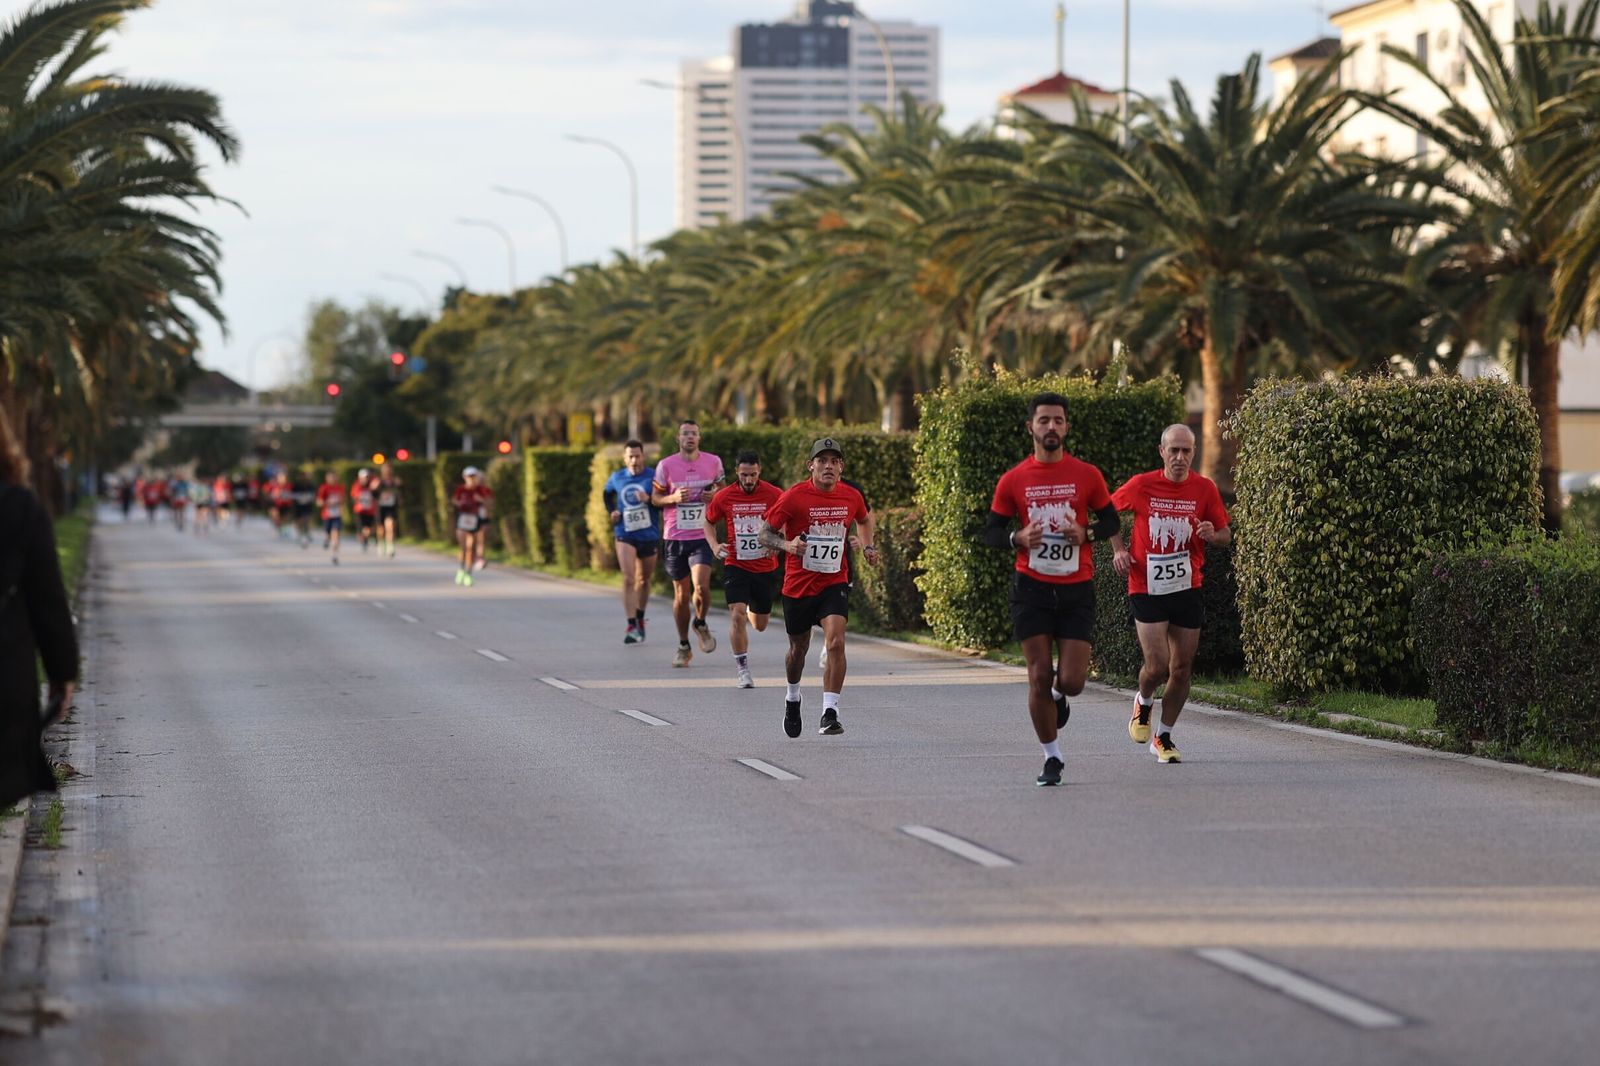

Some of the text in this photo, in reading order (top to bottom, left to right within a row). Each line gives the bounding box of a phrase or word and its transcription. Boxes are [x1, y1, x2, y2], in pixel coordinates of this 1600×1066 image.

[1025, 490, 1050, 498] CIUDAD
[1150, 502, 1174, 510] CIUDAD
[627, 511, 646, 523] 361
[681, 508, 702, 520] 157
[810, 544, 839, 560] 176
[1038, 542, 1074, 561] 280
[1154, 562, 1186, 580] 255
